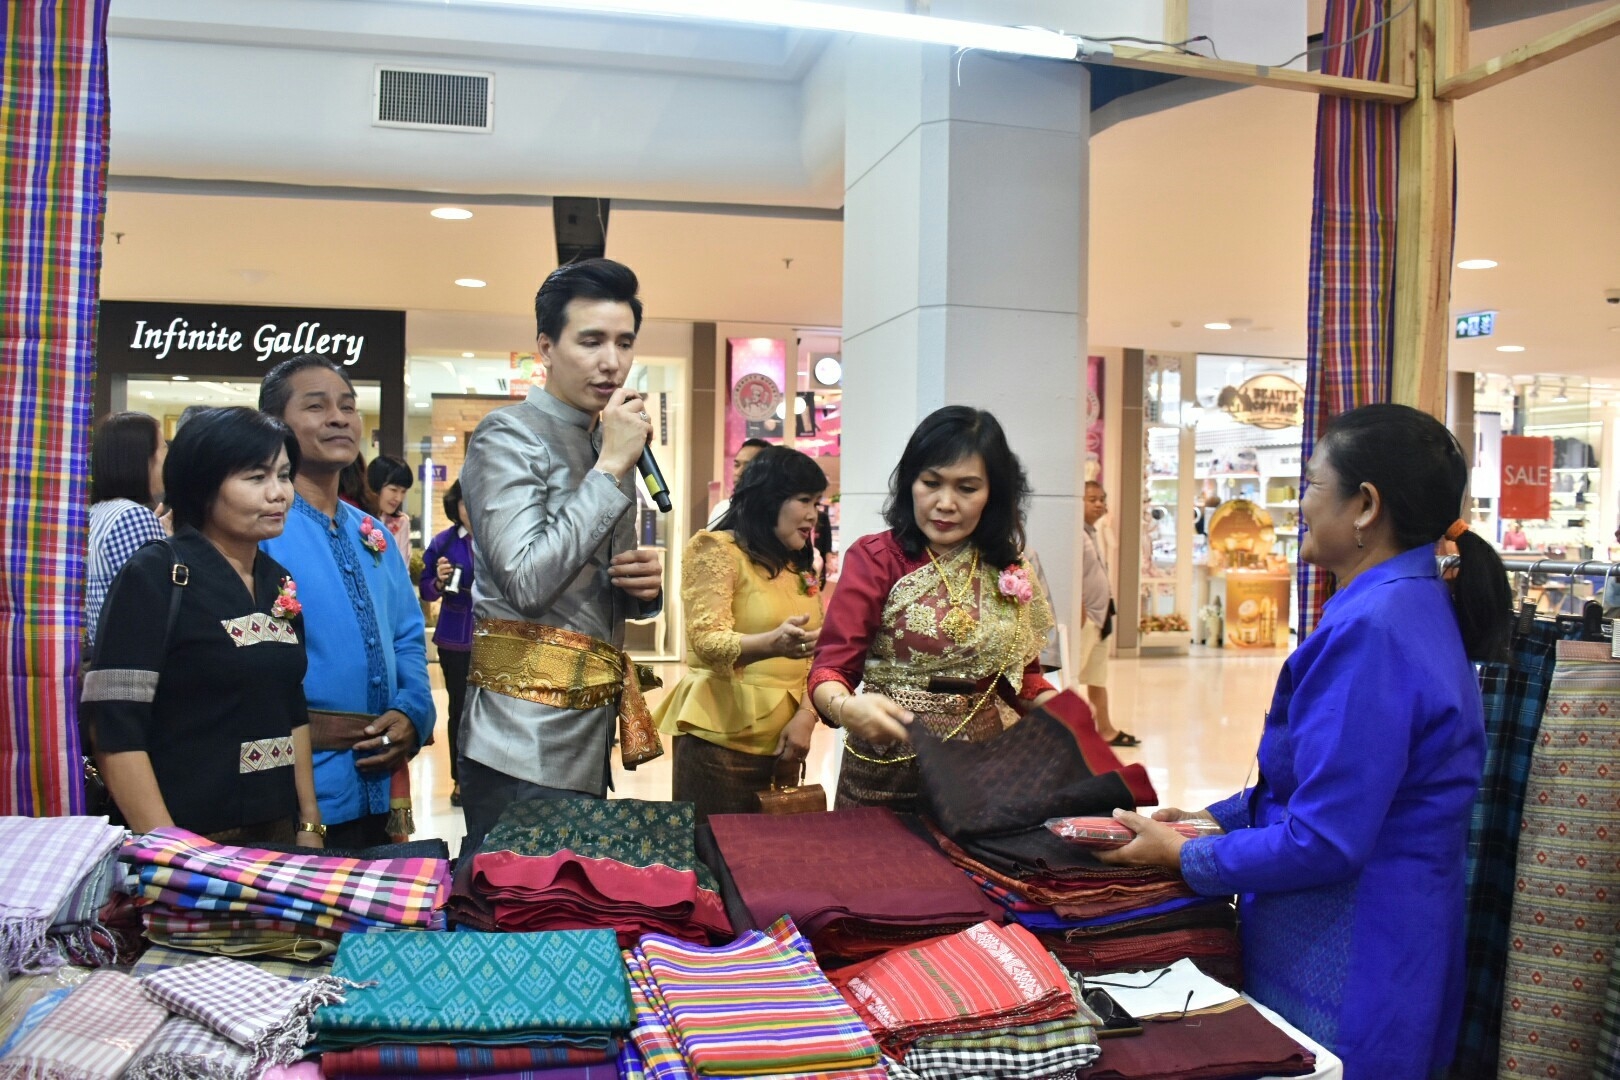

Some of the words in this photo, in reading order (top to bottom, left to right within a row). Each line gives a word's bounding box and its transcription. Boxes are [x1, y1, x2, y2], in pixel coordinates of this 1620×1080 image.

[130, 317, 242, 360] Infinite
[253, 322, 364, 366] Gallery
[1253, 388, 1298, 401] BEAUTY
[1504, 464, 1548, 486] SALE
